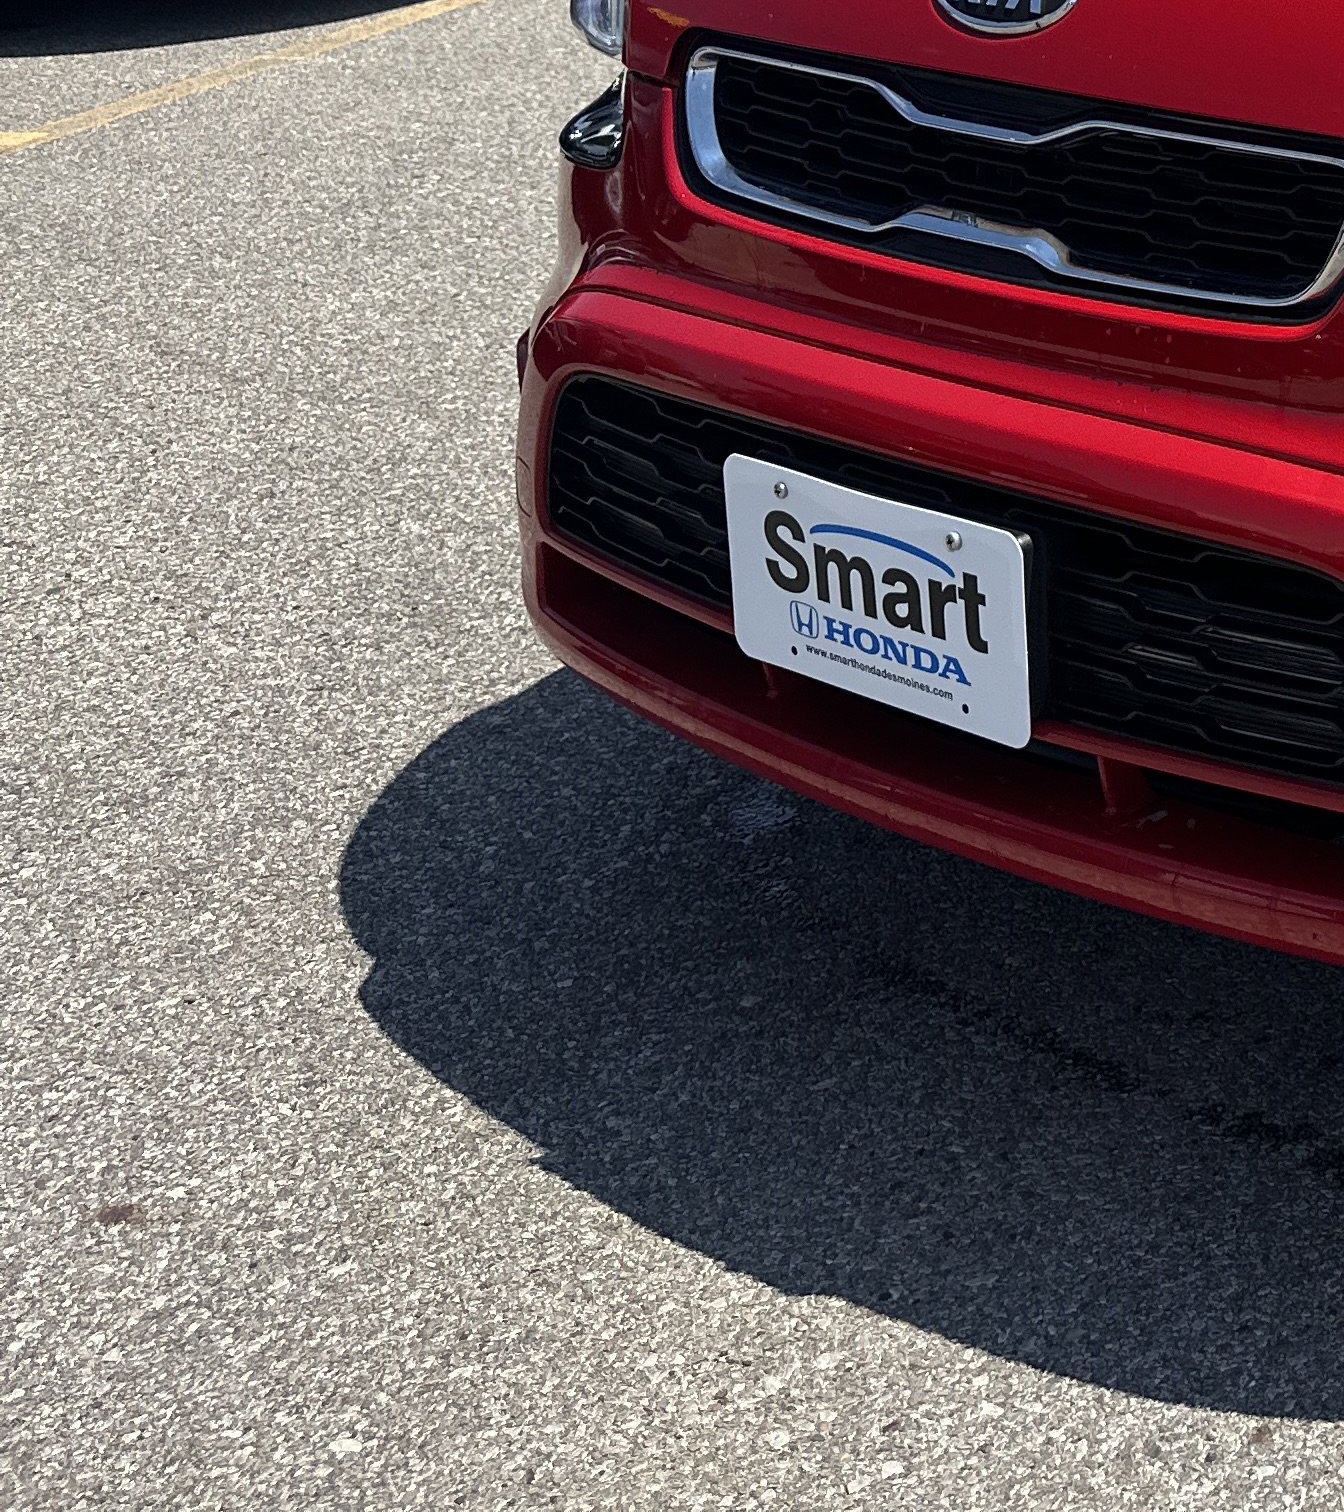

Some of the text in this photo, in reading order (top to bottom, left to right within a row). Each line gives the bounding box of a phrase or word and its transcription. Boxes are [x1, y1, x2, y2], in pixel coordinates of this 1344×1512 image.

[763, 509, 989, 655] Smart
[805, 643, 954, 701] www.smarthondadesmoines.com
[822, 615, 972, 687] HONDA
